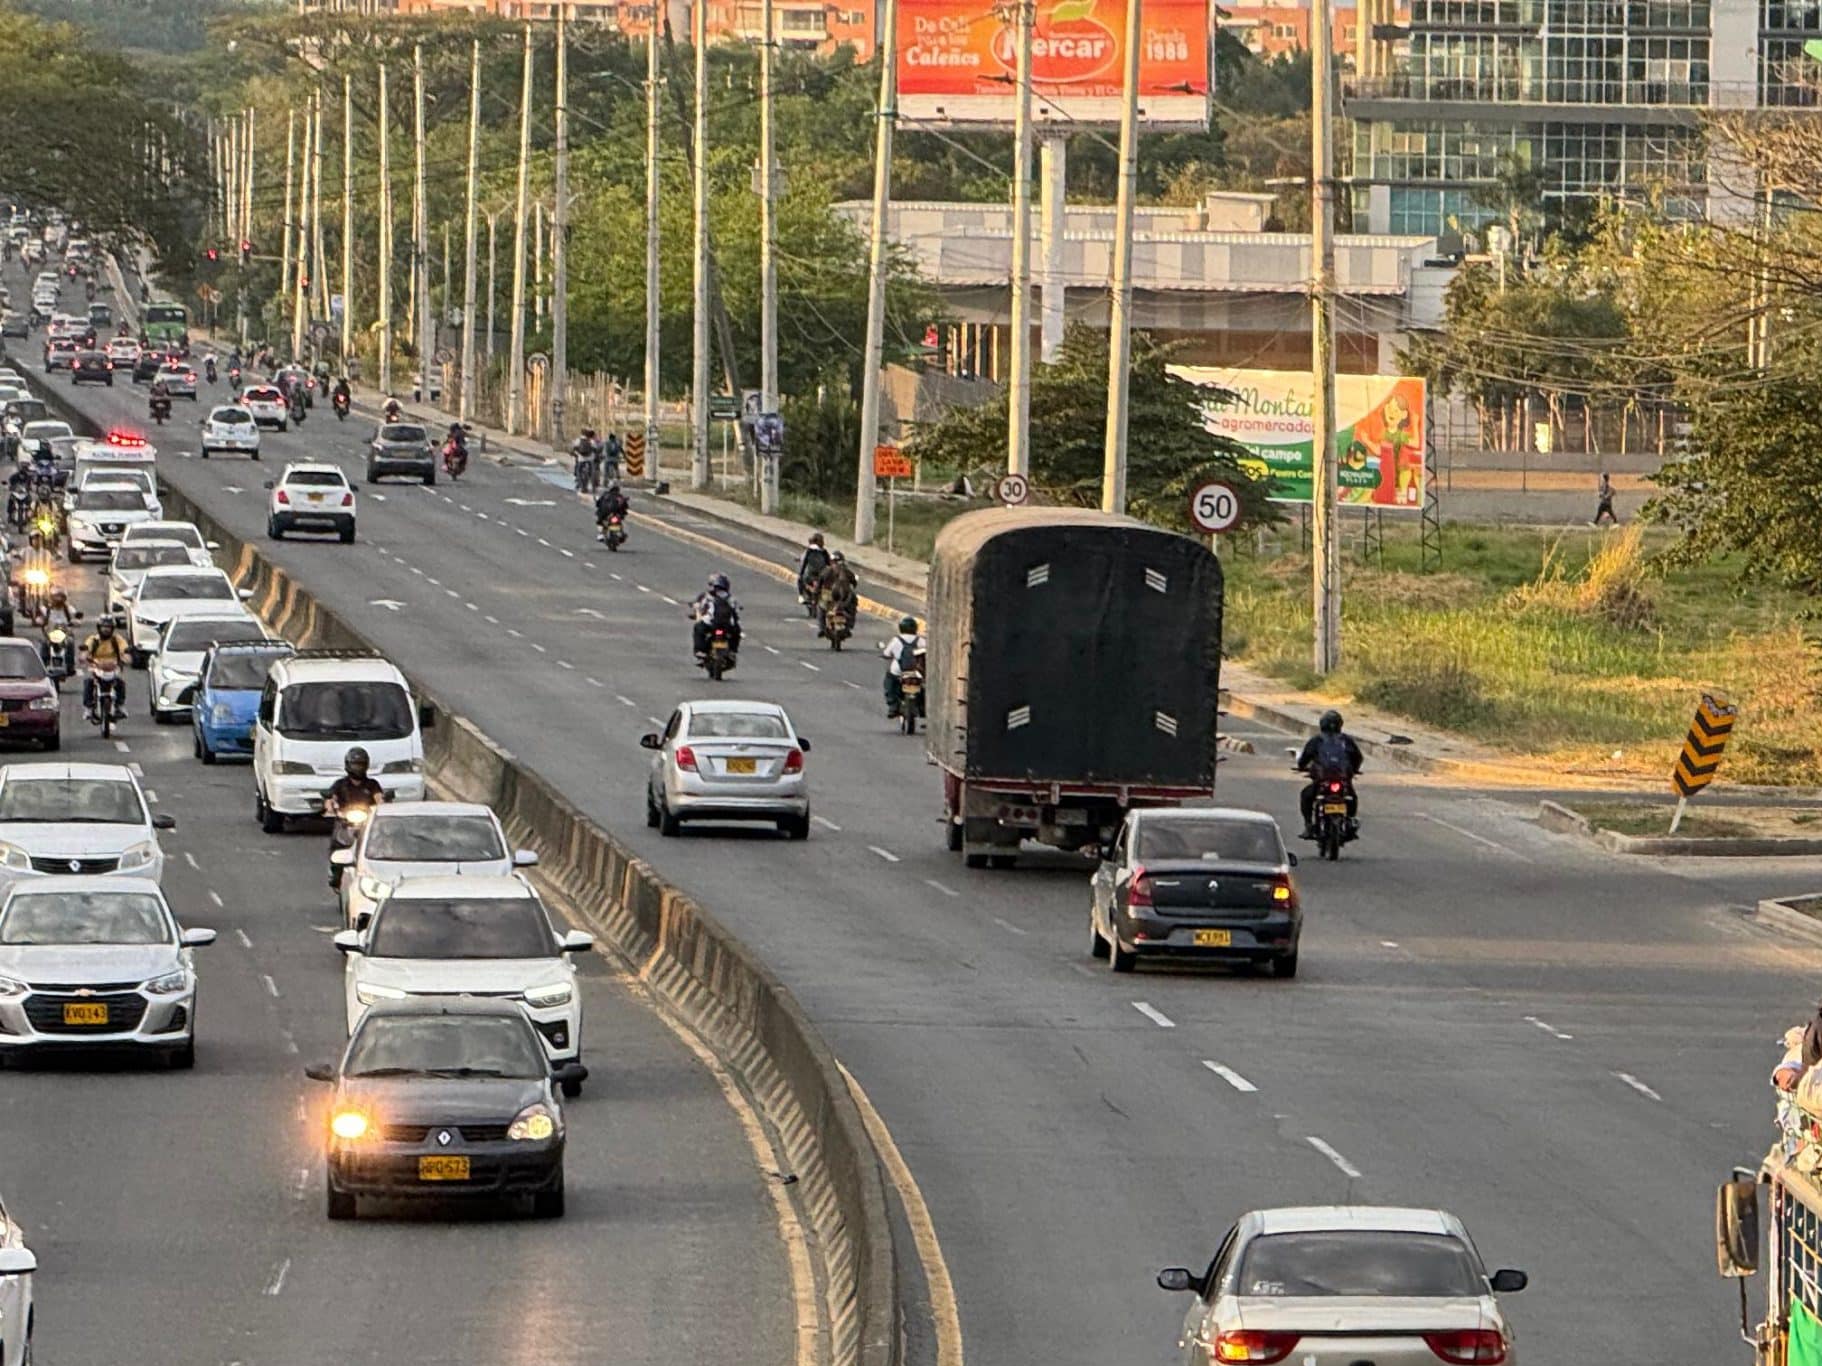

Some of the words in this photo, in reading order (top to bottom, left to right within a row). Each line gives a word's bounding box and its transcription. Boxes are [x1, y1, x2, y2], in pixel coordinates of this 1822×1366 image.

[1261, 448, 1302, 464] campo
[1004, 481, 1022, 497] 30
[1199, 494, 1232, 519] 50
